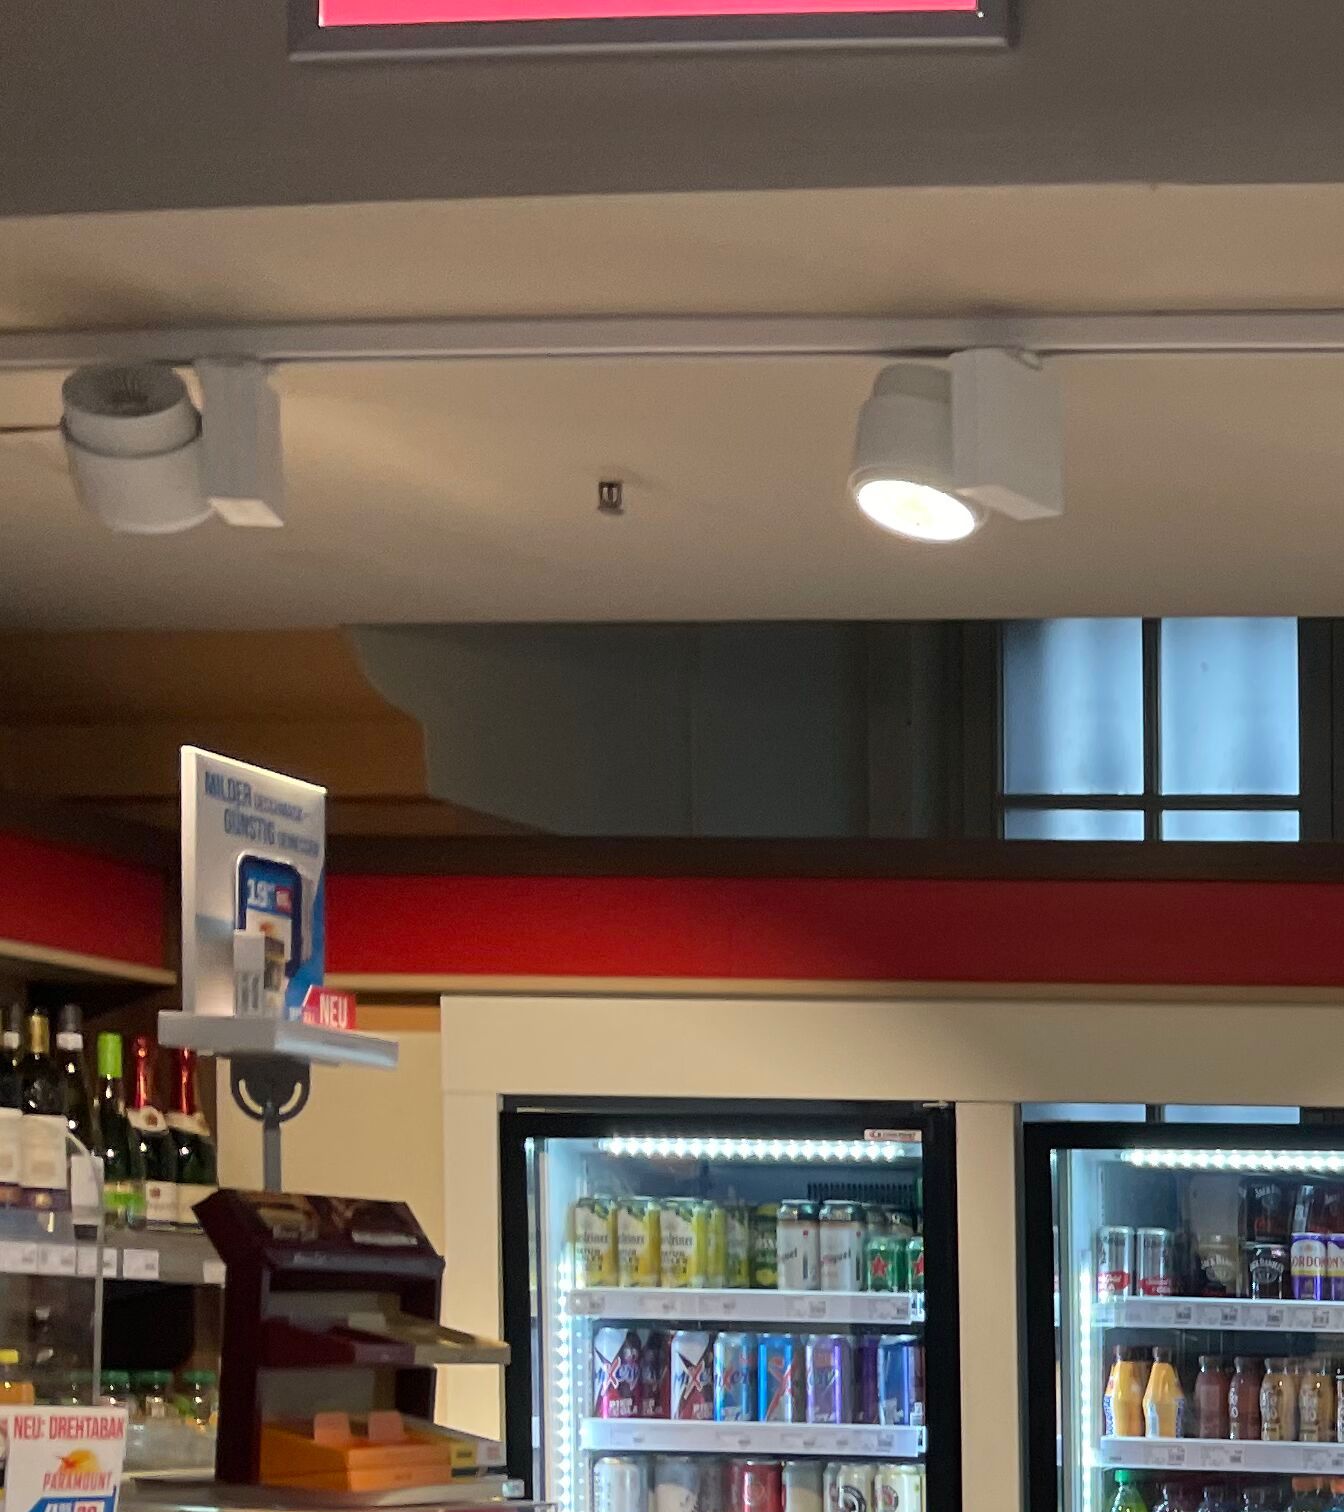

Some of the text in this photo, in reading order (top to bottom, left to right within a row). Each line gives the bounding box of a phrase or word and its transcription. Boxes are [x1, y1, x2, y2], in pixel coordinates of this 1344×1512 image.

[320, 994, 348, 1030] NEU
[14, 1415, 126, 1441] NEU: DREHTABAK
